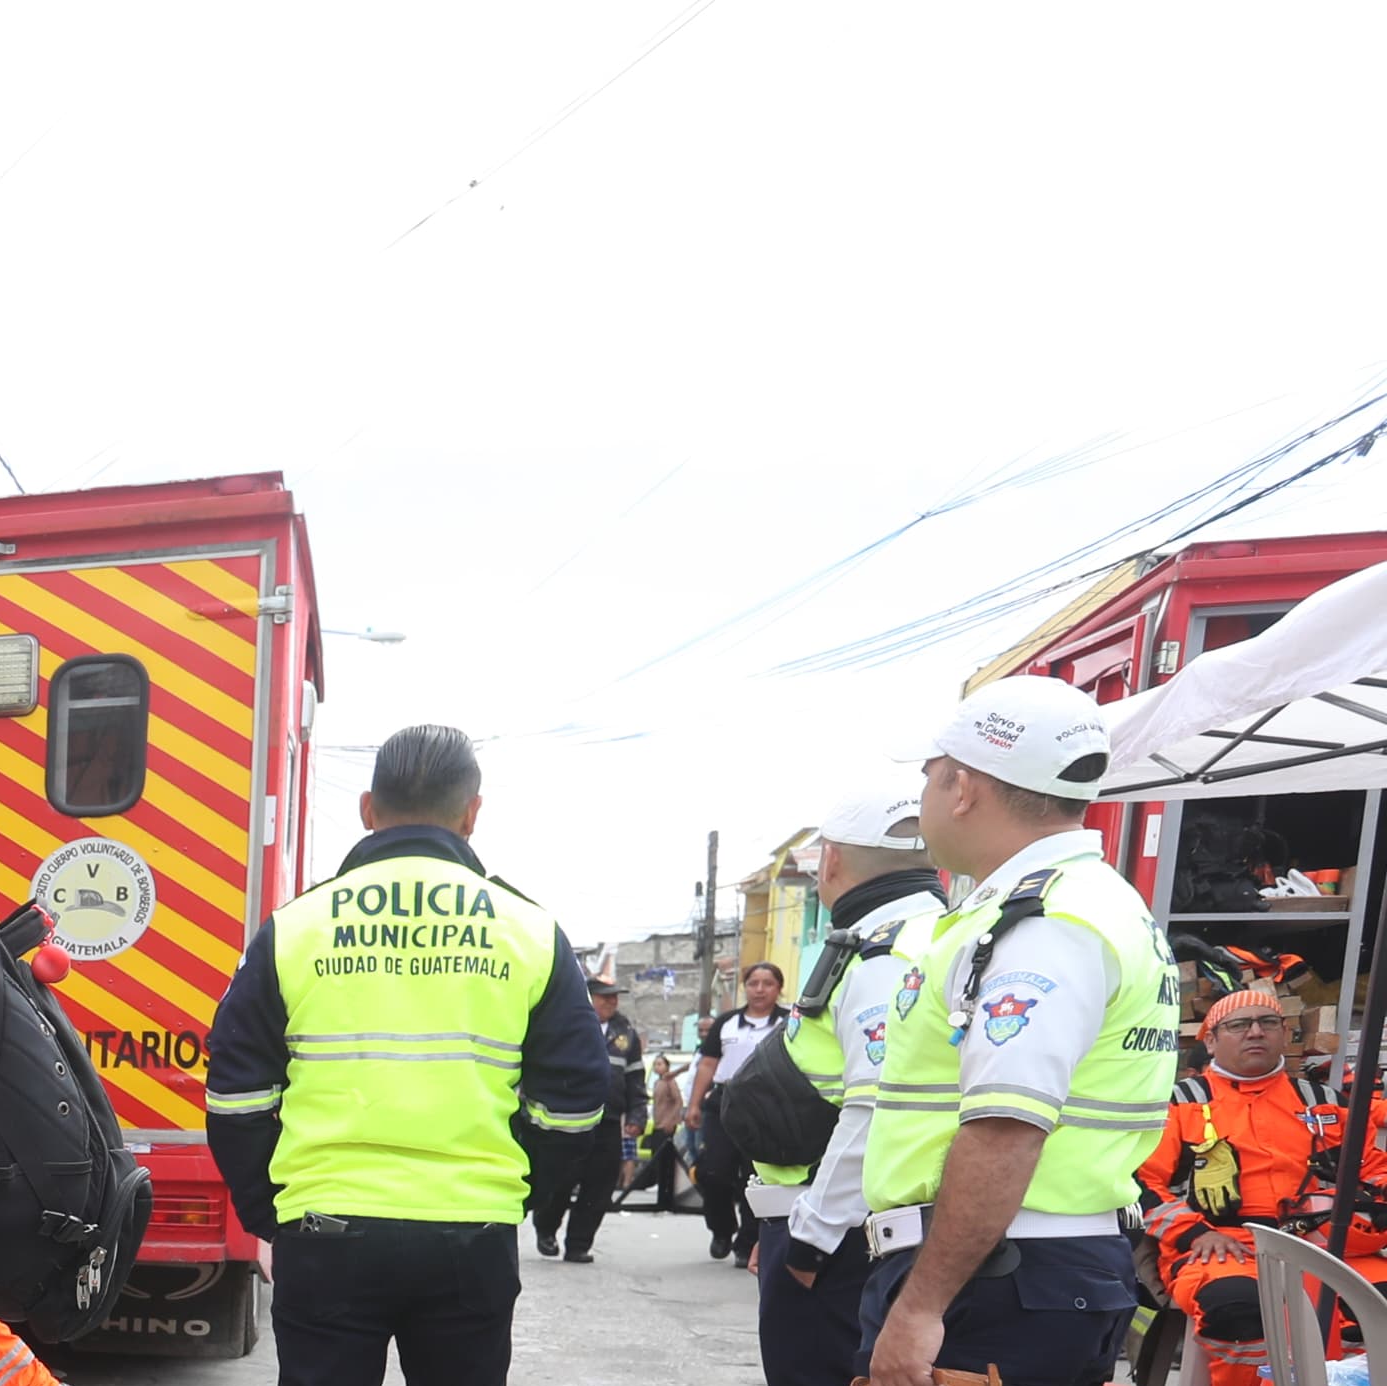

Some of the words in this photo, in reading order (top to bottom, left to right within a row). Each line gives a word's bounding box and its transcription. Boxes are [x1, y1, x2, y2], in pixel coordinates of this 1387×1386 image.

[987, 712, 1015, 729] Sirvo
[985, 724, 1019, 742] Ciudad
[47, 848, 78, 873] CUERPO
[80, 843, 134, 866] VOLUNTARIO
[87, 864, 100, 878] V
[131, 863, 144, 876] DE
[53, 888, 66, 903] C
[116, 886, 128, 901] B
[134, 876, 151, 925] BOMBEROS
[332, 881, 495, 918] POLICIA
[333, 924, 493, 949] MUNICIPAL
[315, 956, 377, 977] CIUDAD
[385, 957, 402, 975] DE
[410, 956, 509, 981] GUATEMALA
[85, 1030, 211, 1070] ITARIO
[101, 1317, 211, 1336] HINO
